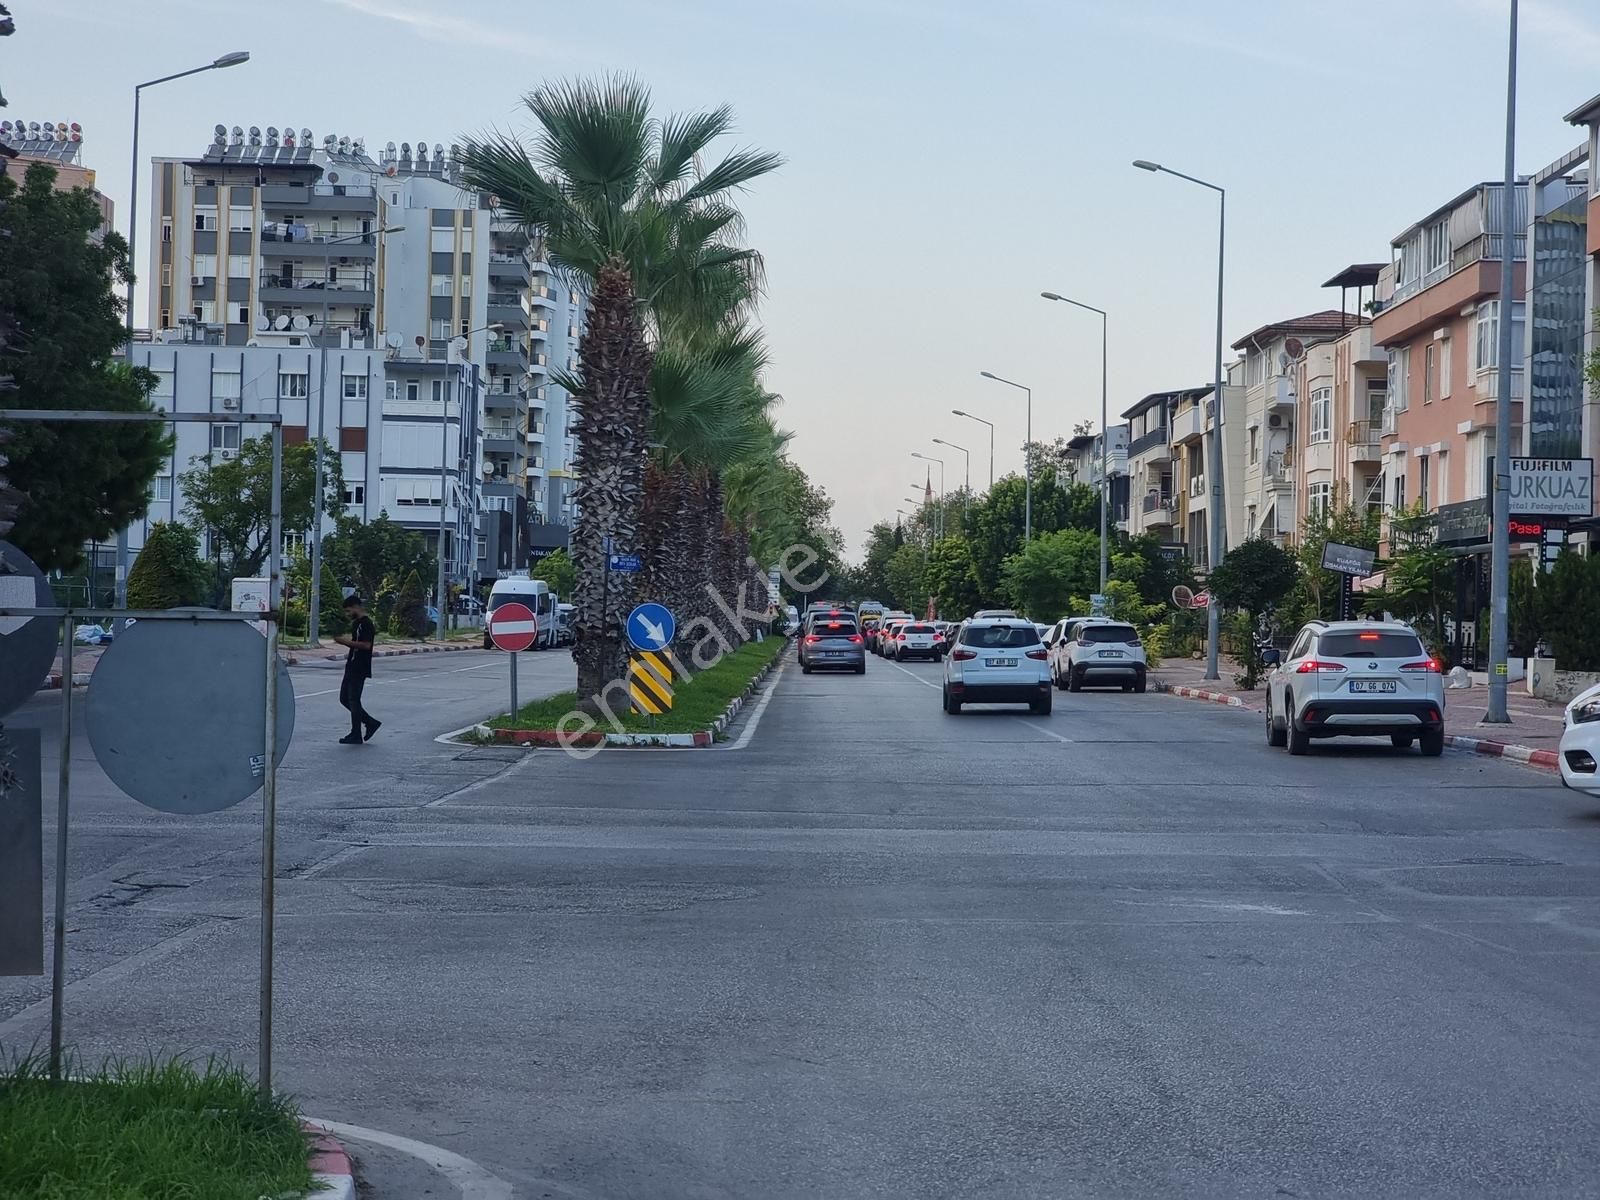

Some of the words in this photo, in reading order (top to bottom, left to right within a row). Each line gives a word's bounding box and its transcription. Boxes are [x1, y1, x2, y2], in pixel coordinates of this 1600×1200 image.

[1512, 460, 1572, 472] FUJIFILM
[1508, 475, 1589, 499] URKUAZ
[1355, 682, 1364, 690] 07
[1381, 682, 1395, 690] 074
